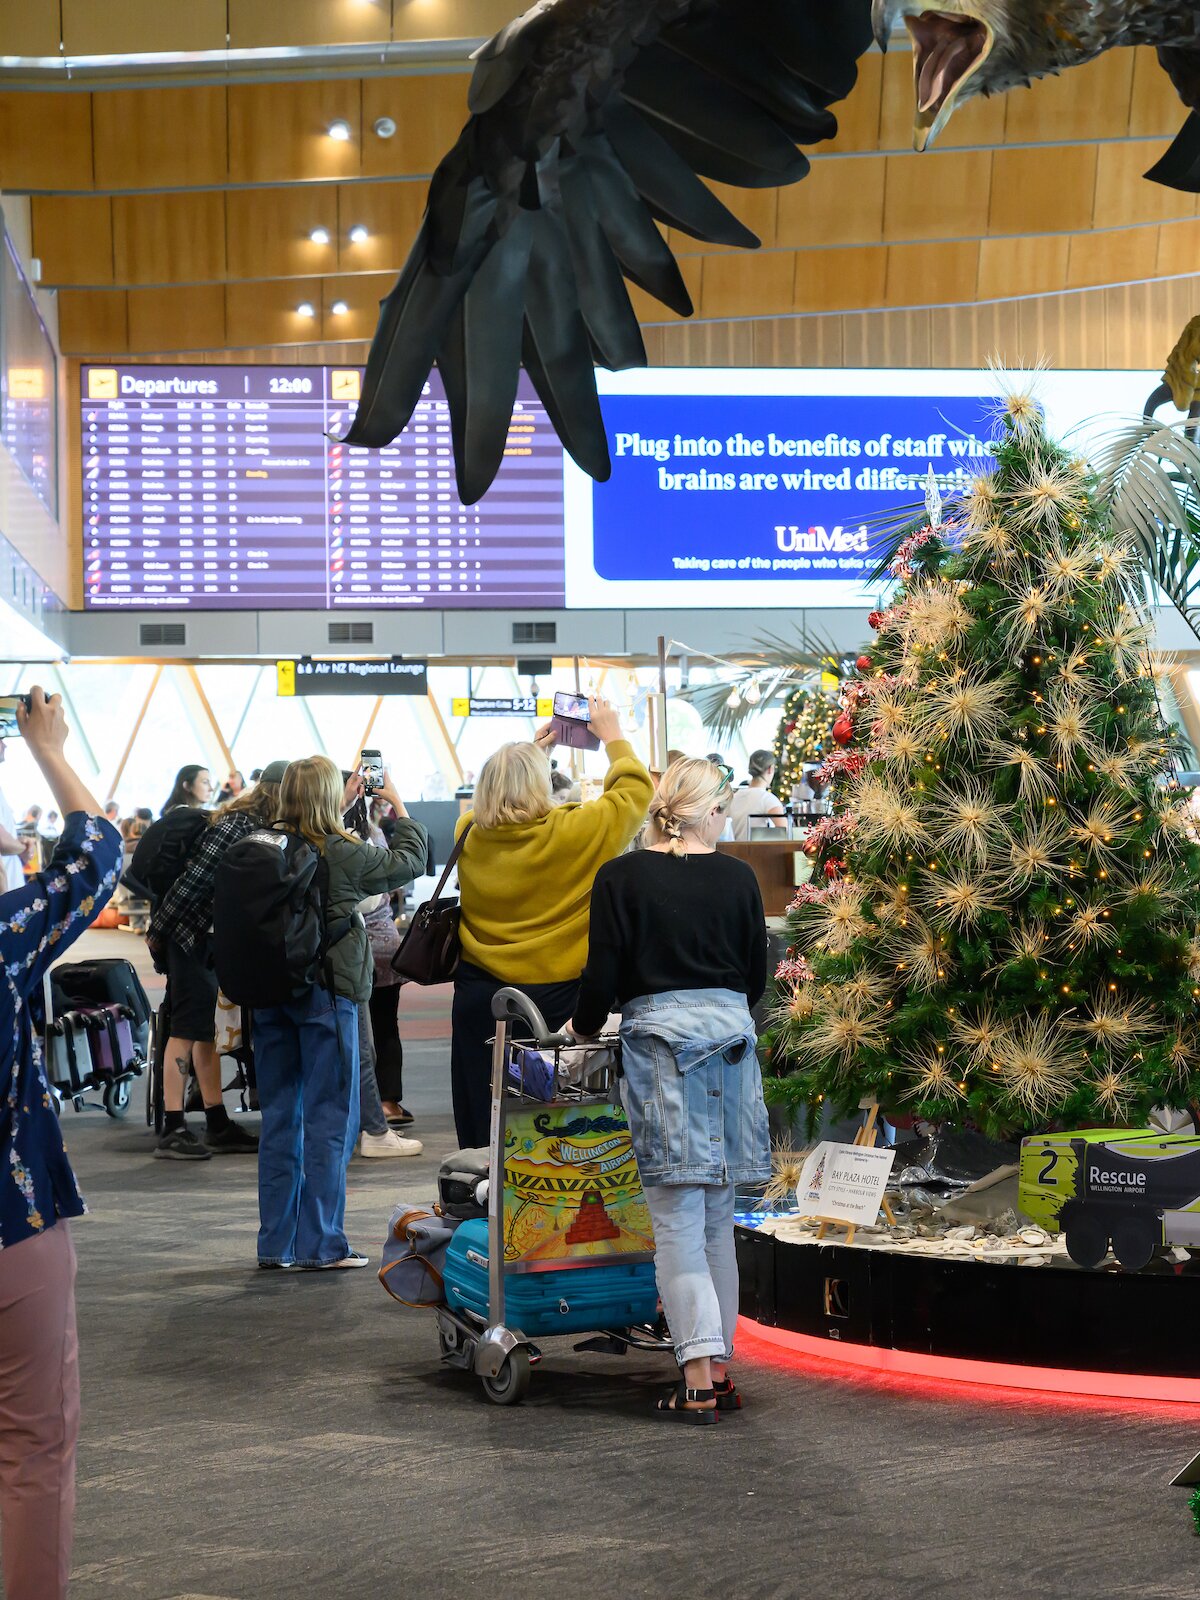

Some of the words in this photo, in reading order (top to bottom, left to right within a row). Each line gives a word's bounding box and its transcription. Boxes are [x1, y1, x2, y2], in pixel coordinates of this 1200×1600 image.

[121, 375, 217, 397] Departures
[615, 433, 670, 461] Plug
[673, 433, 723, 457] into
[726, 434, 765, 457] the
[768, 434, 861, 457] benefits
[865, 434, 892, 457] of
[893, 434, 946, 457] staff
[658, 468, 737, 490] brains
[740, 473, 778, 490] are
[781, 468, 851, 490] wired
[775, 526, 869, 552] UniMed
[672, 557, 710, 572] Taking
[711, 558, 737, 568] care
[738, 557, 751, 568] of
[752, 557, 771, 568] the
[773, 558, 811, 572] people
[812, 557, 838, 568] who
[315, 663, 330, 673] Air
[332, 662, 347, 673] NZ
[348, 662, 389, 676] Regional
[390, 663, 425, 676] Lounge
[559, 1137, 622, 1161] WELLINGTON
[600, 1149, 634, 1174] AIRPORT
[1038, 1150, 1057, 1185] 2
[832, 1170, 843, 1179] BAY
[843, 1172, 860, 1182] PLAZA
[861, 1175, 880, 1186] HOTEL
[1090, 1166, 1147, 1186] Rescue
[1090, 1184, 1122, 1193] WELLINGTON
[1124, 1186, 1146, 1194] AIRPORT
